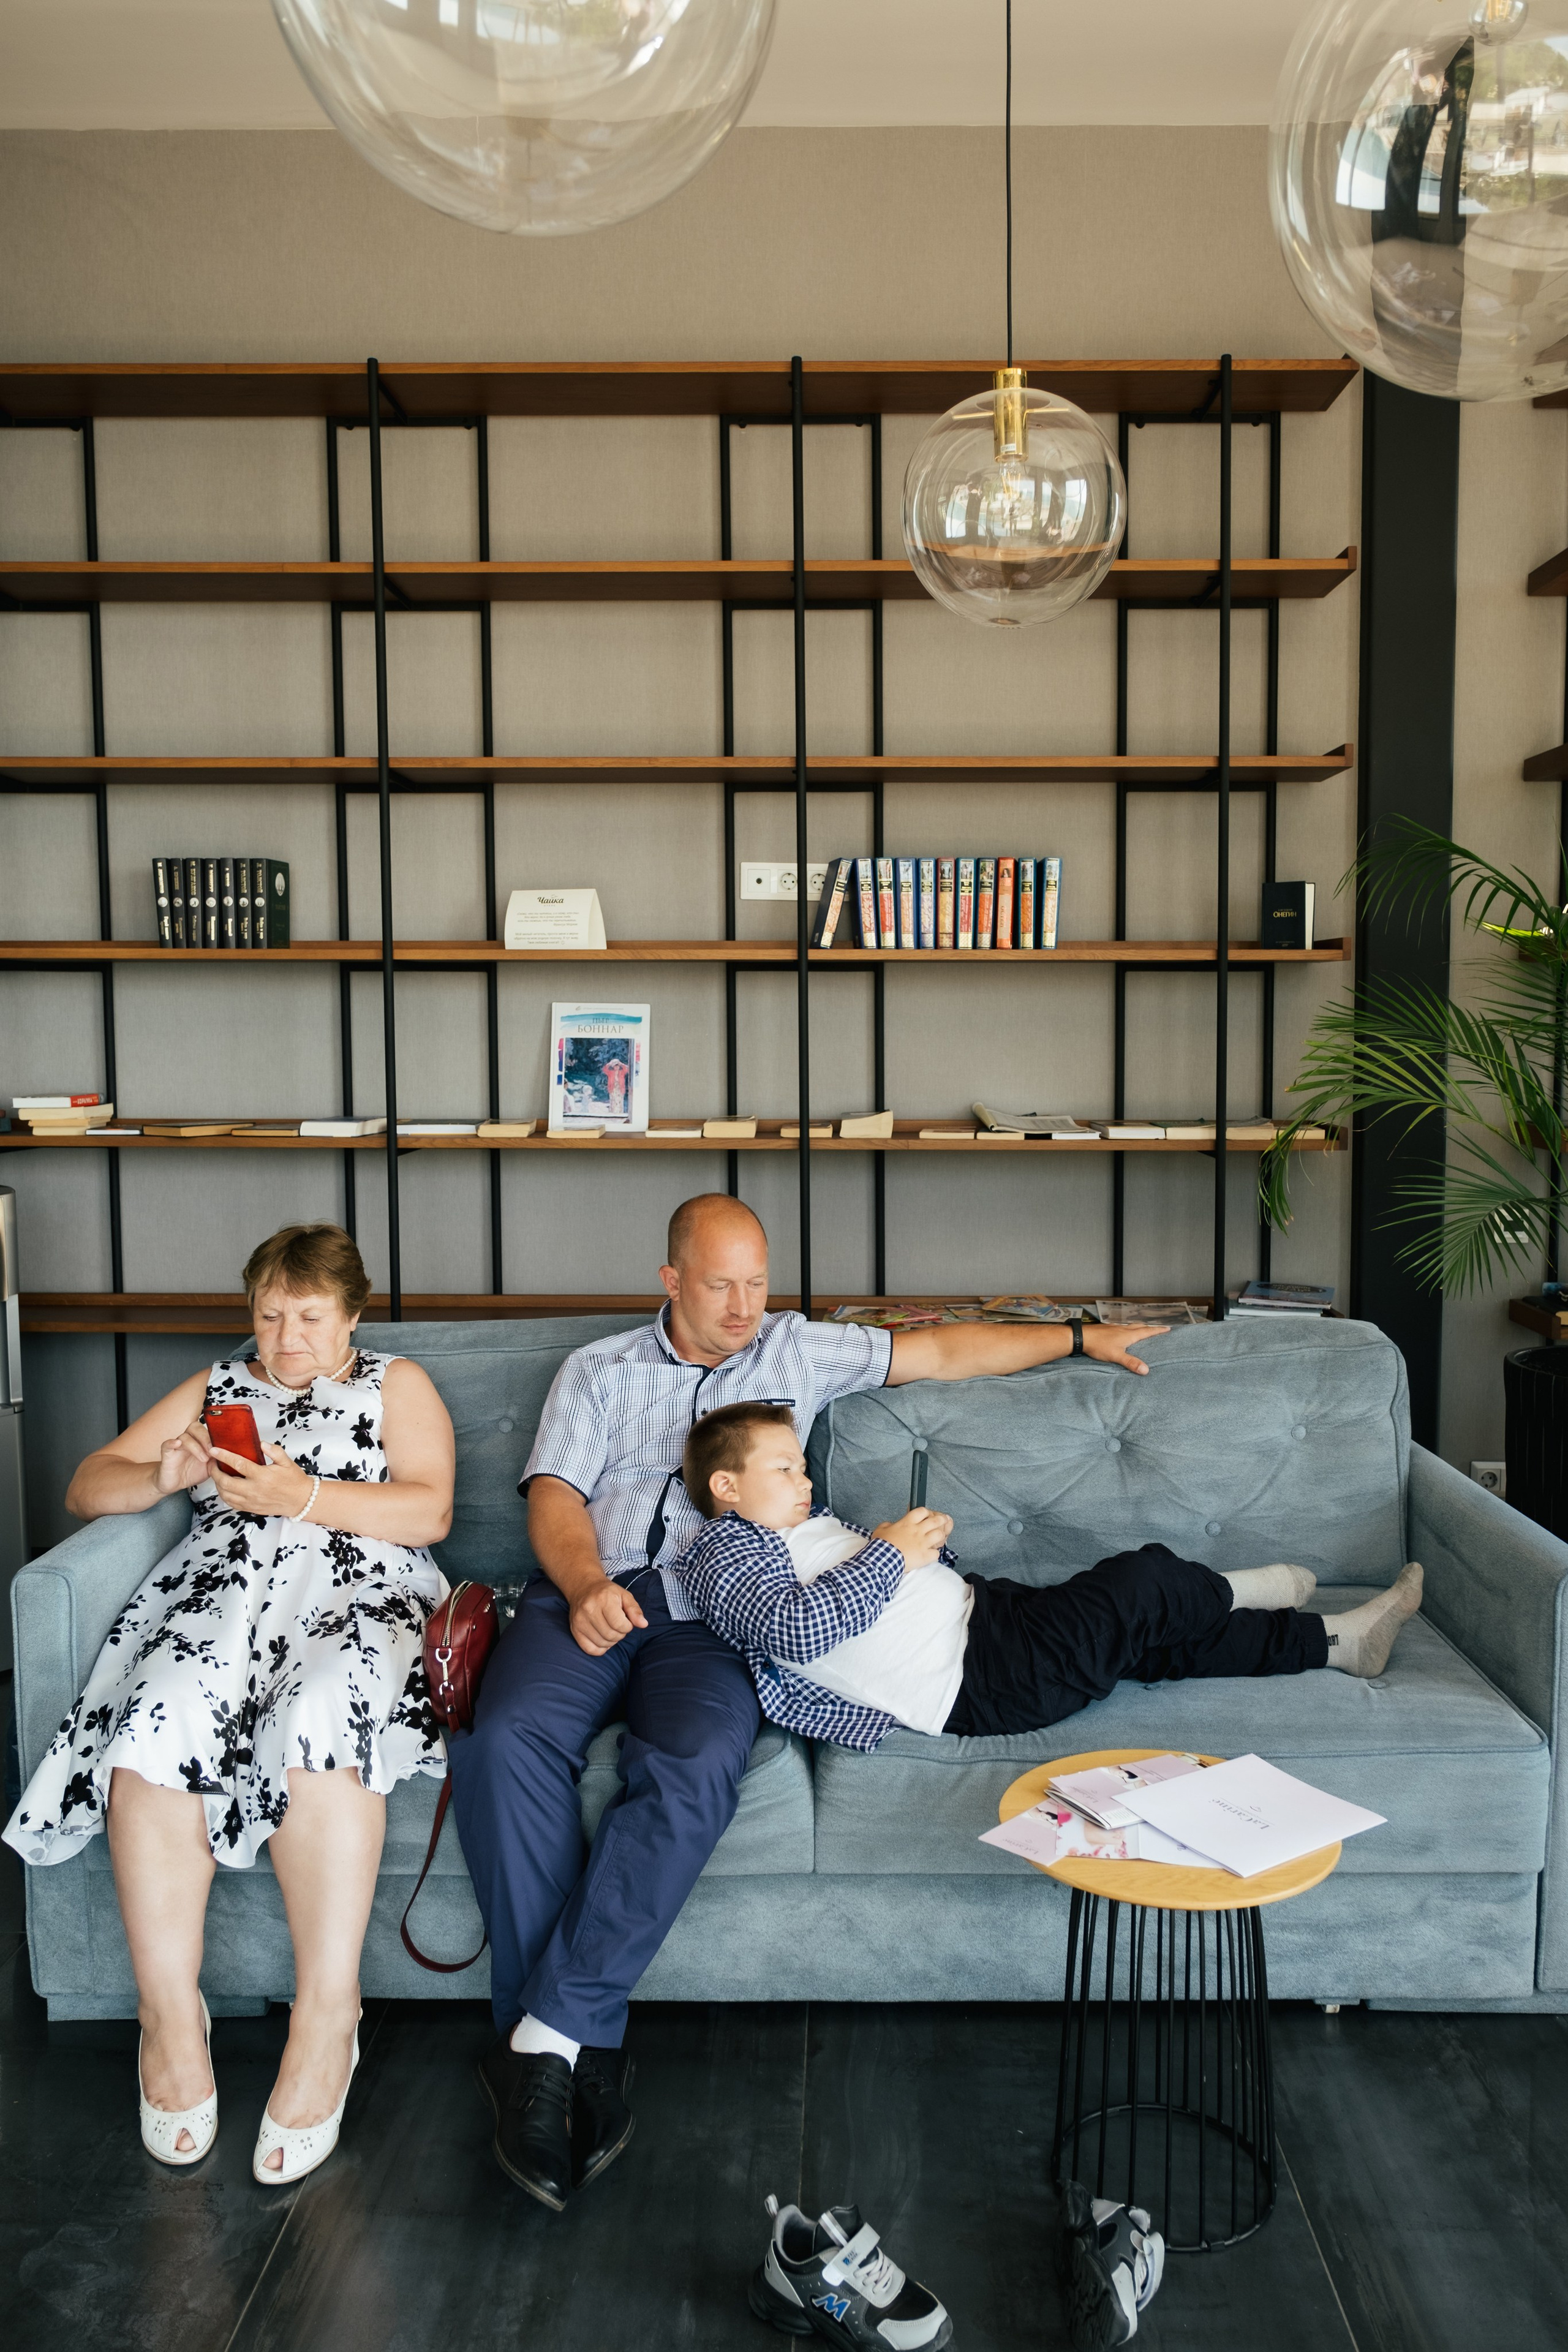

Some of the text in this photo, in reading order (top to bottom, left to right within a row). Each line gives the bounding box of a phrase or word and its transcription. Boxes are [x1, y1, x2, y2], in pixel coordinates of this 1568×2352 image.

[537, 895, 564, 904] Чайка
[578, 1025, 624, 1033] БОННАР
[812, 2293, 851, 2322] M
